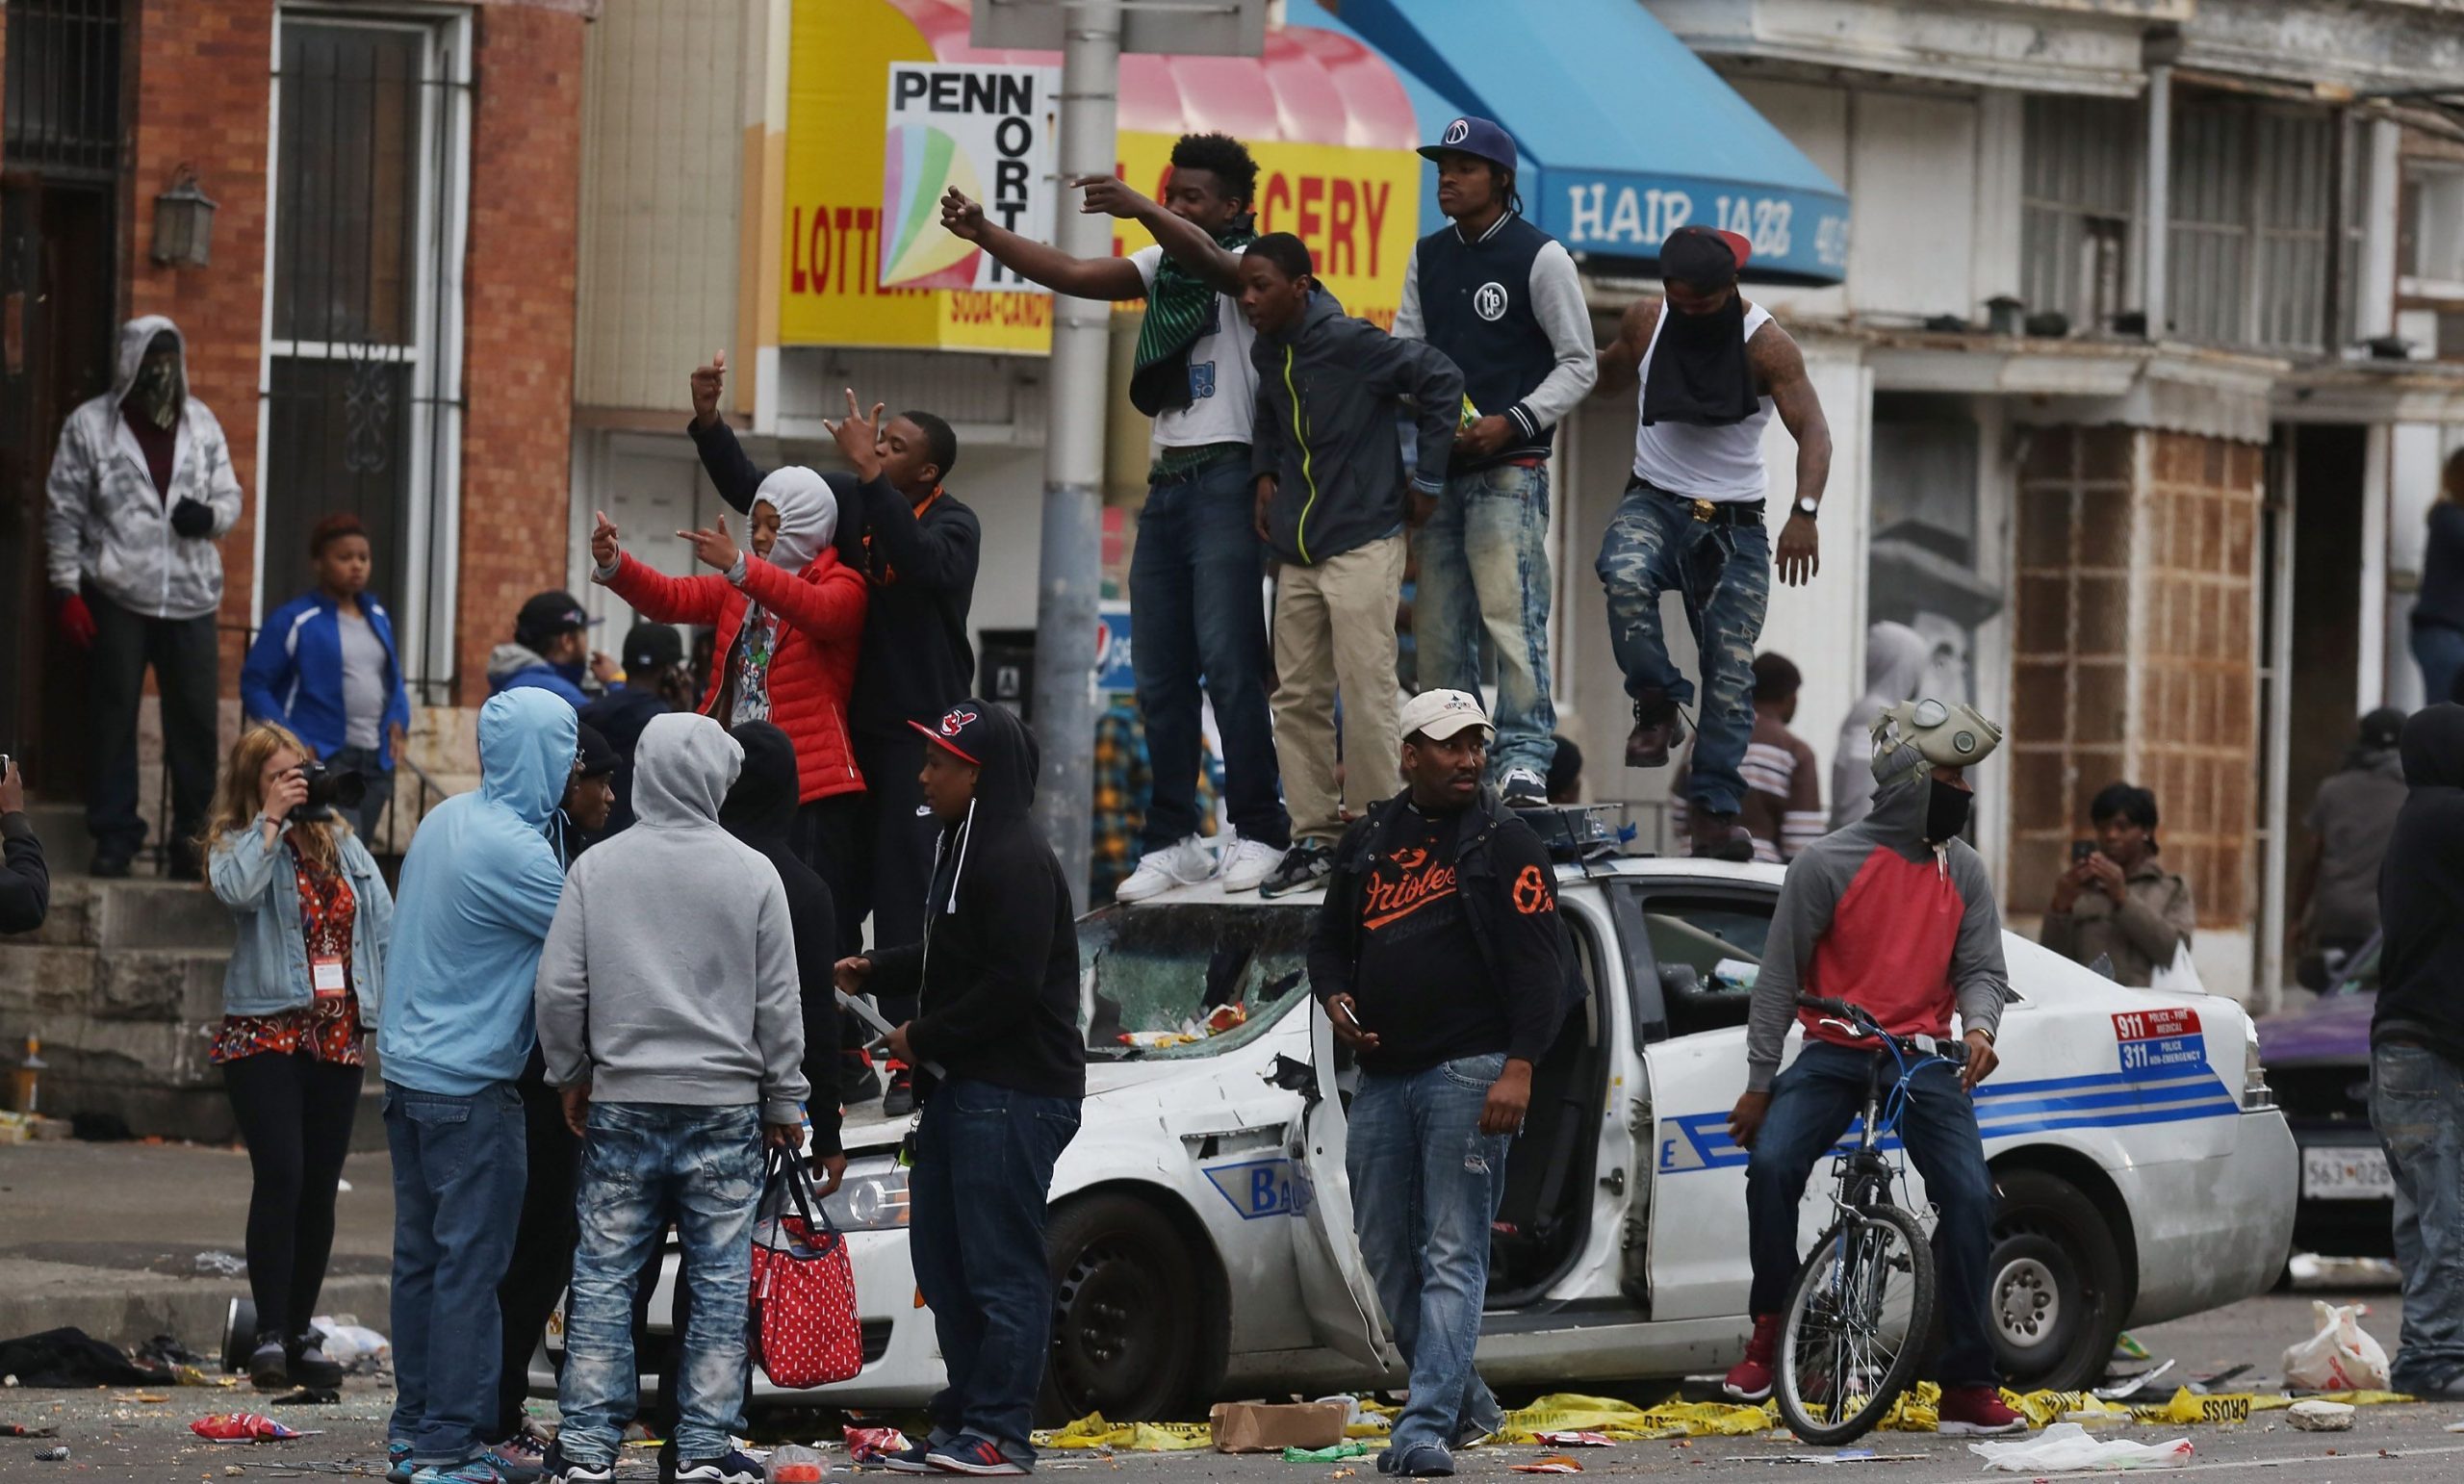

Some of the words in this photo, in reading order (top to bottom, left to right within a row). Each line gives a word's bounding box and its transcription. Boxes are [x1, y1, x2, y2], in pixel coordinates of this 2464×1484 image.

[894, 71, 1033, 115] PENN
[2118, 1013, 2144, 1038] 911
[2147, 1011, 2170, 1023] POLICE
[2156, 1022, 2183, 1034] MEDICAL
[2123, 1042, 2149, 1069] 311
[2161, 1040, 2183, 1051] POLICE
[2202, 1398, 2249, 1421] CROSS
